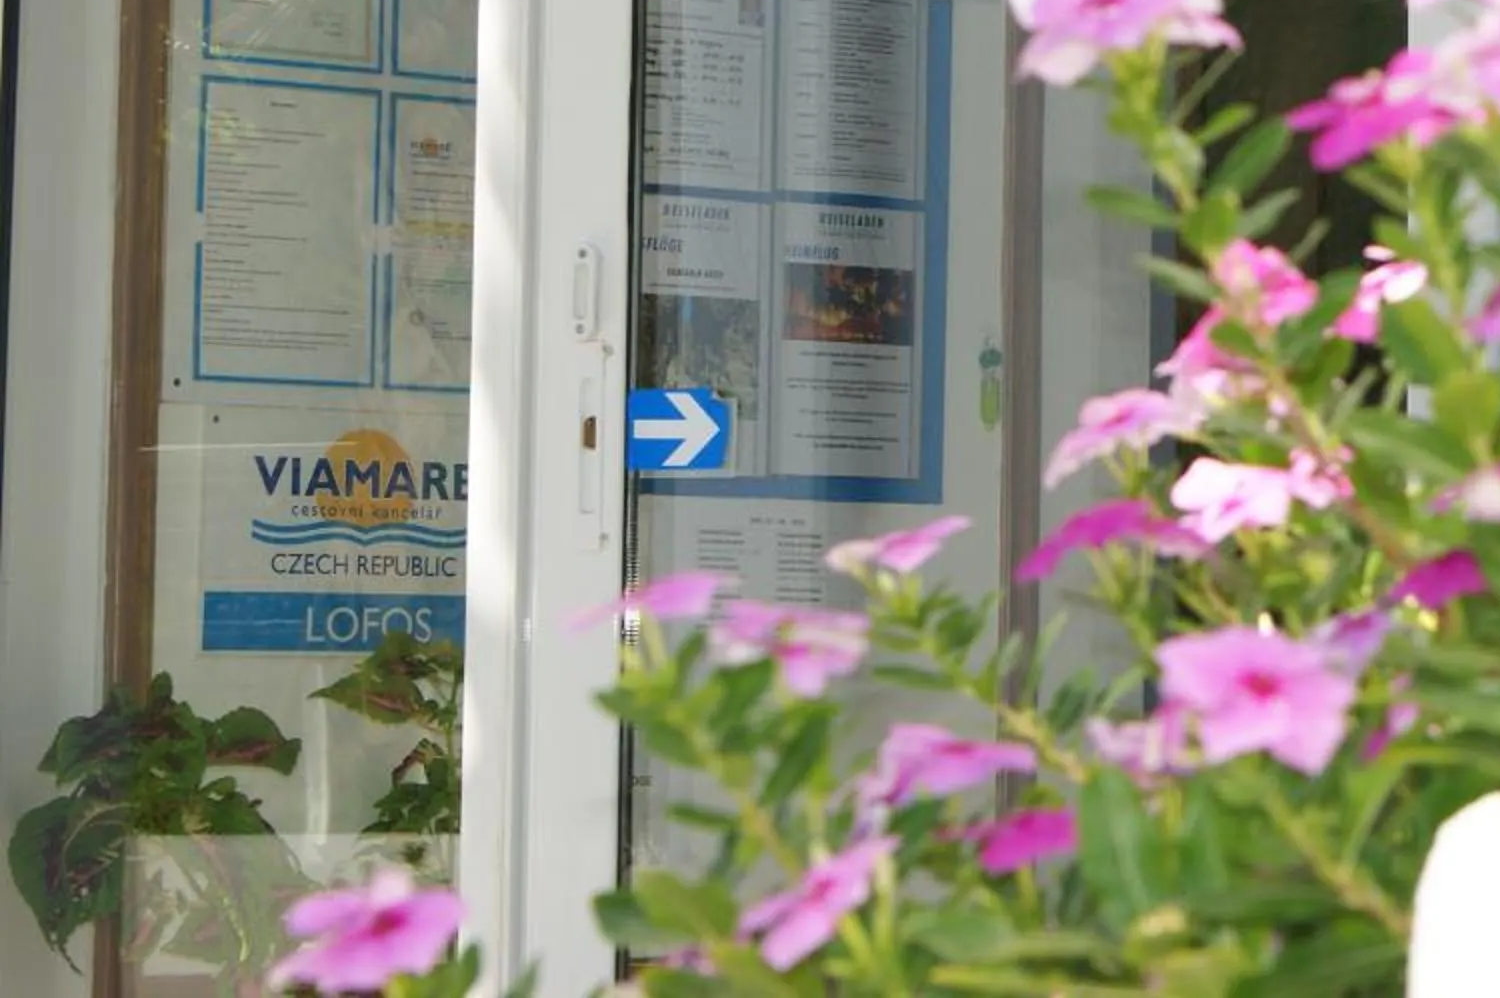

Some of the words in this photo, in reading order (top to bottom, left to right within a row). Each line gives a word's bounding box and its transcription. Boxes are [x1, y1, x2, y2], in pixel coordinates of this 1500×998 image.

[254, 456, 469, 500] VIAMARE
[271, 553, 349, 575] CZECH
[357, 556, 458, 578] REPUBLIC
[306, 606, 433, 643] LOFOS
